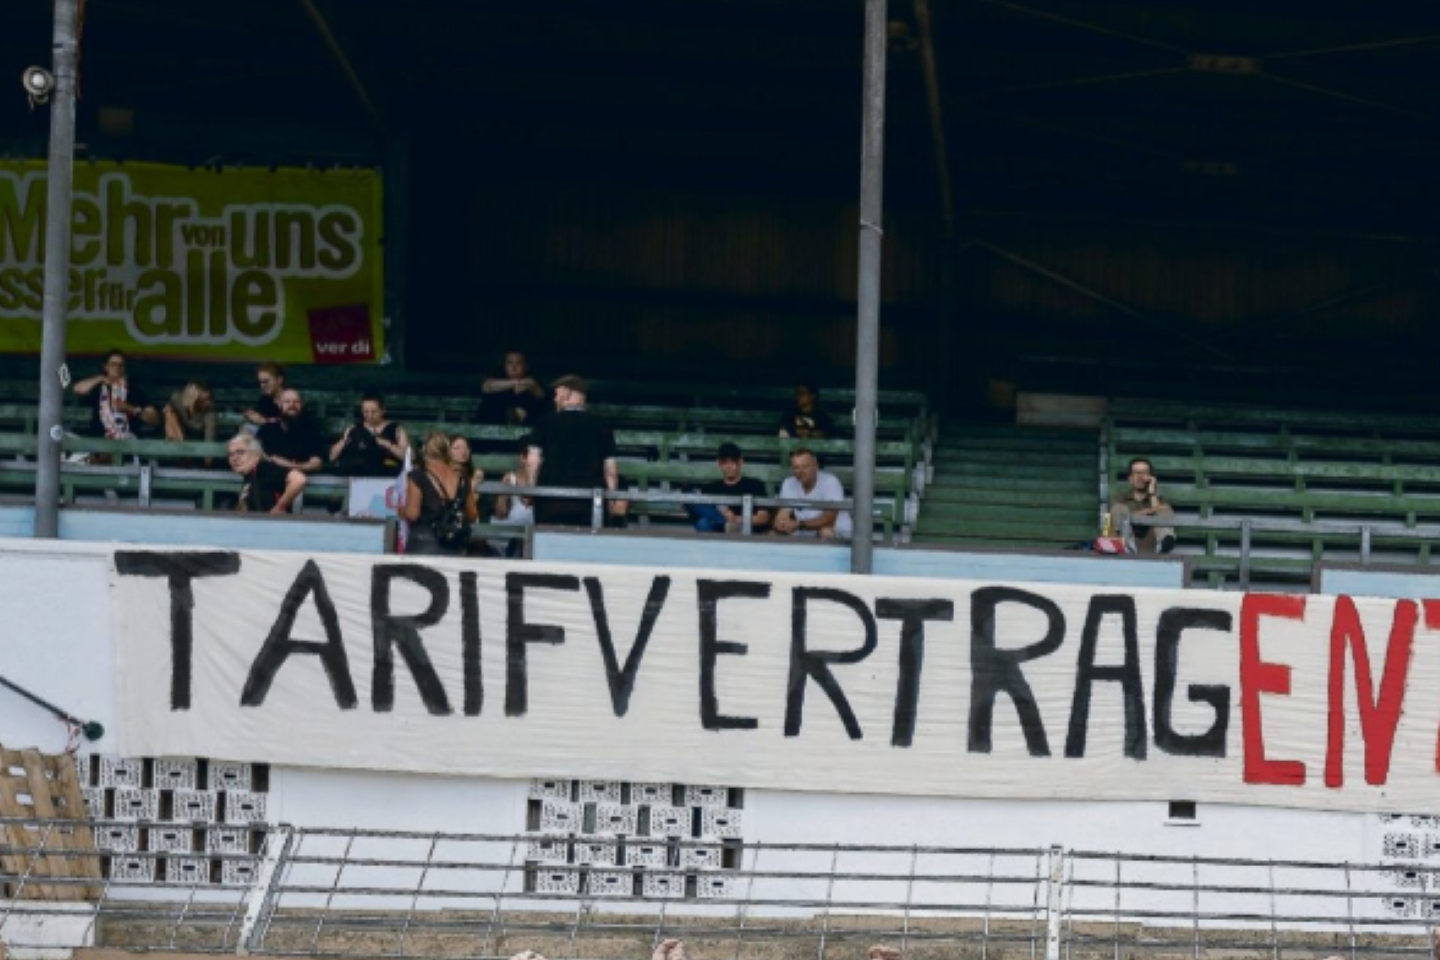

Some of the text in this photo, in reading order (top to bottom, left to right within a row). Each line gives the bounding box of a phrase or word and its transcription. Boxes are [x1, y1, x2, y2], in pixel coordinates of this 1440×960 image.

[0, 178, 357, 270] Mehr von uns
[97, 283, 136, 311] für
[134, 250, 278, 338] alle
[114, 551, 1232, 760] TARIFVERTRAG
